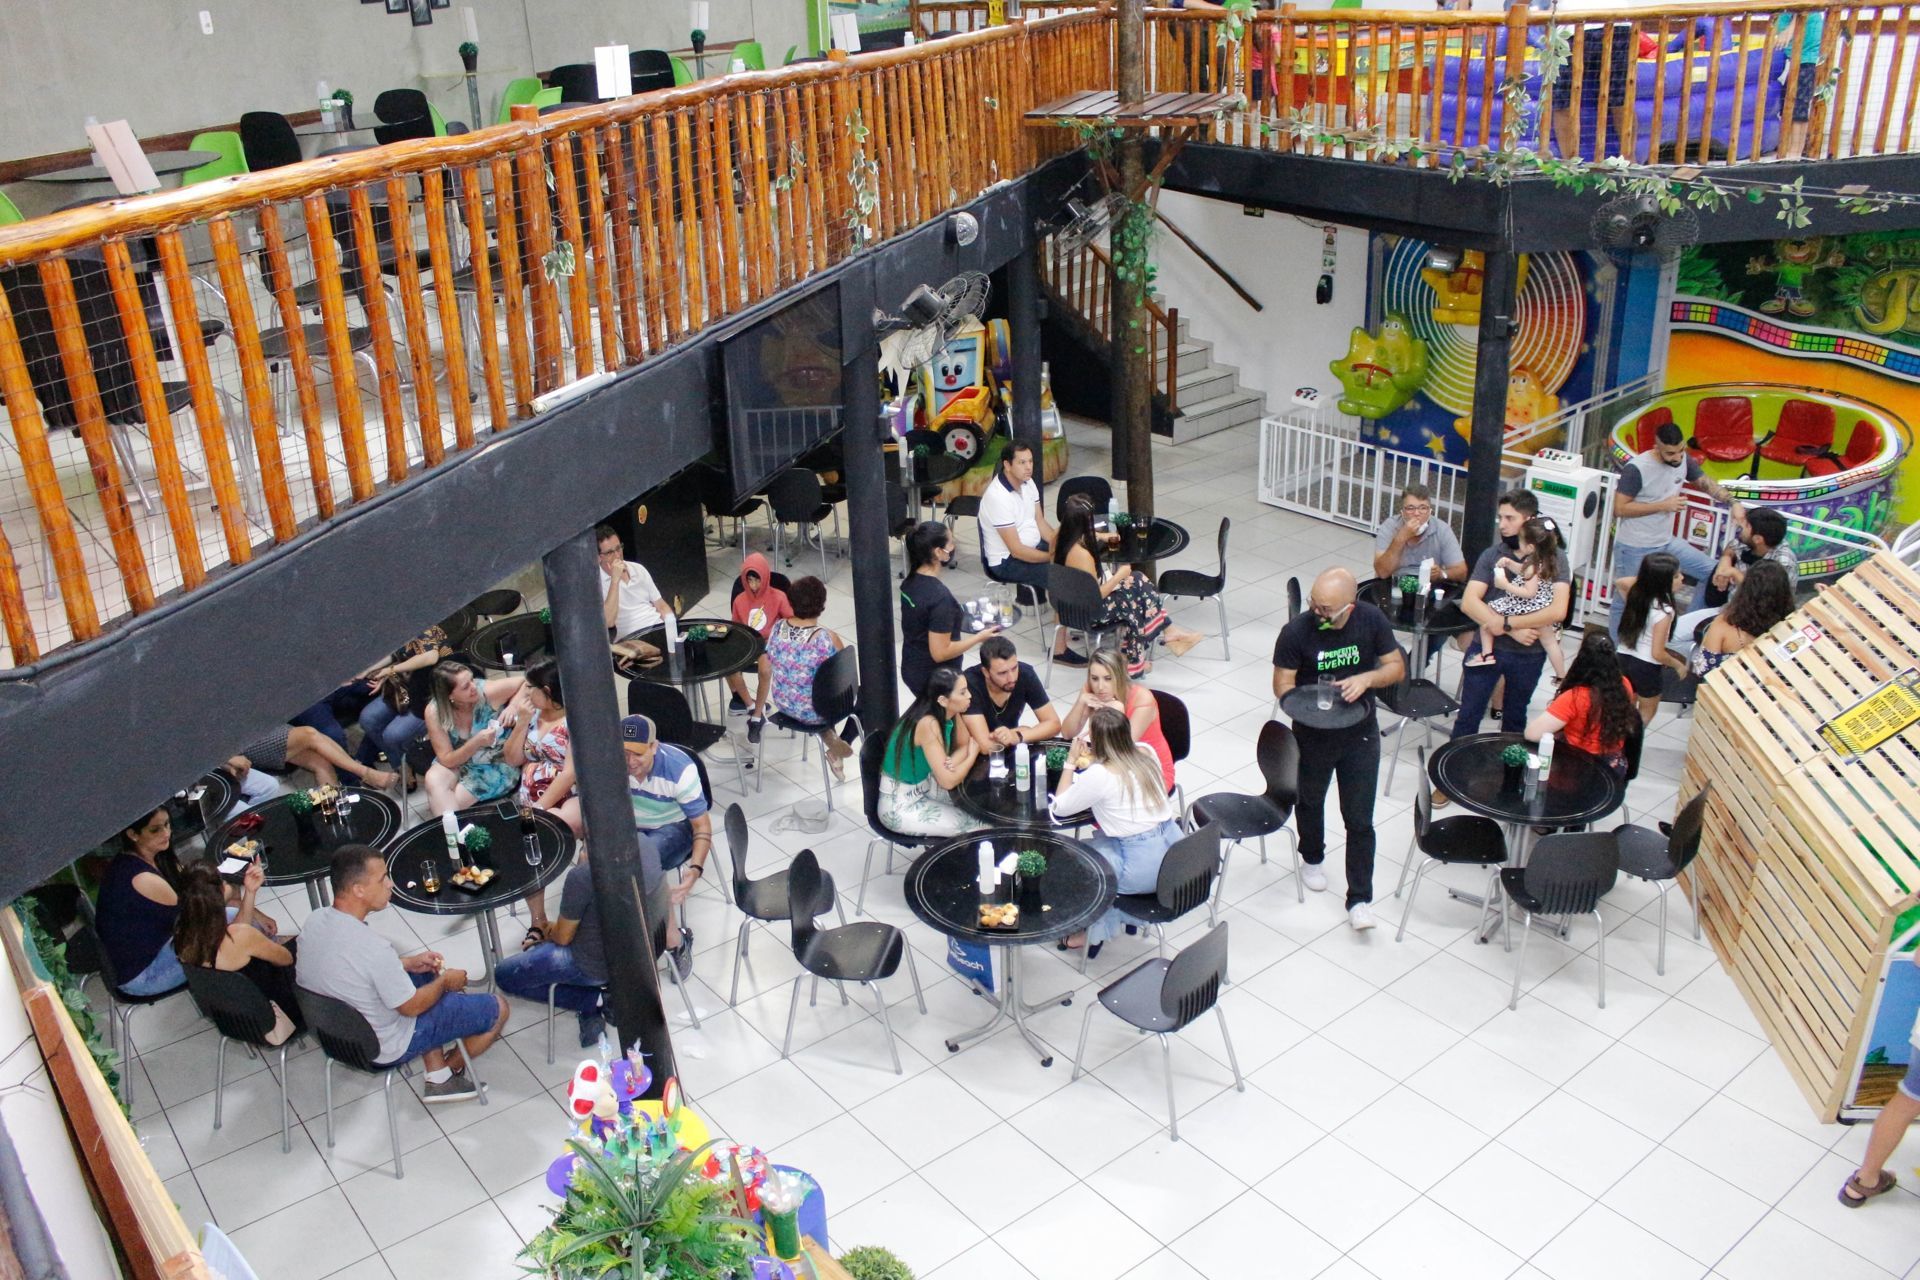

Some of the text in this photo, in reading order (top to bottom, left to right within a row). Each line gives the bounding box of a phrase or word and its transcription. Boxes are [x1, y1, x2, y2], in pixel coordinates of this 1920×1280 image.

[1317, 645, 1358, 660] #PERFEITO
[1317, 655, 1360, 670] EVENTO
[1883, 690, 1916, 718] BRINQUEDO
[1859, 709, 1882, 730] DEVIDO
